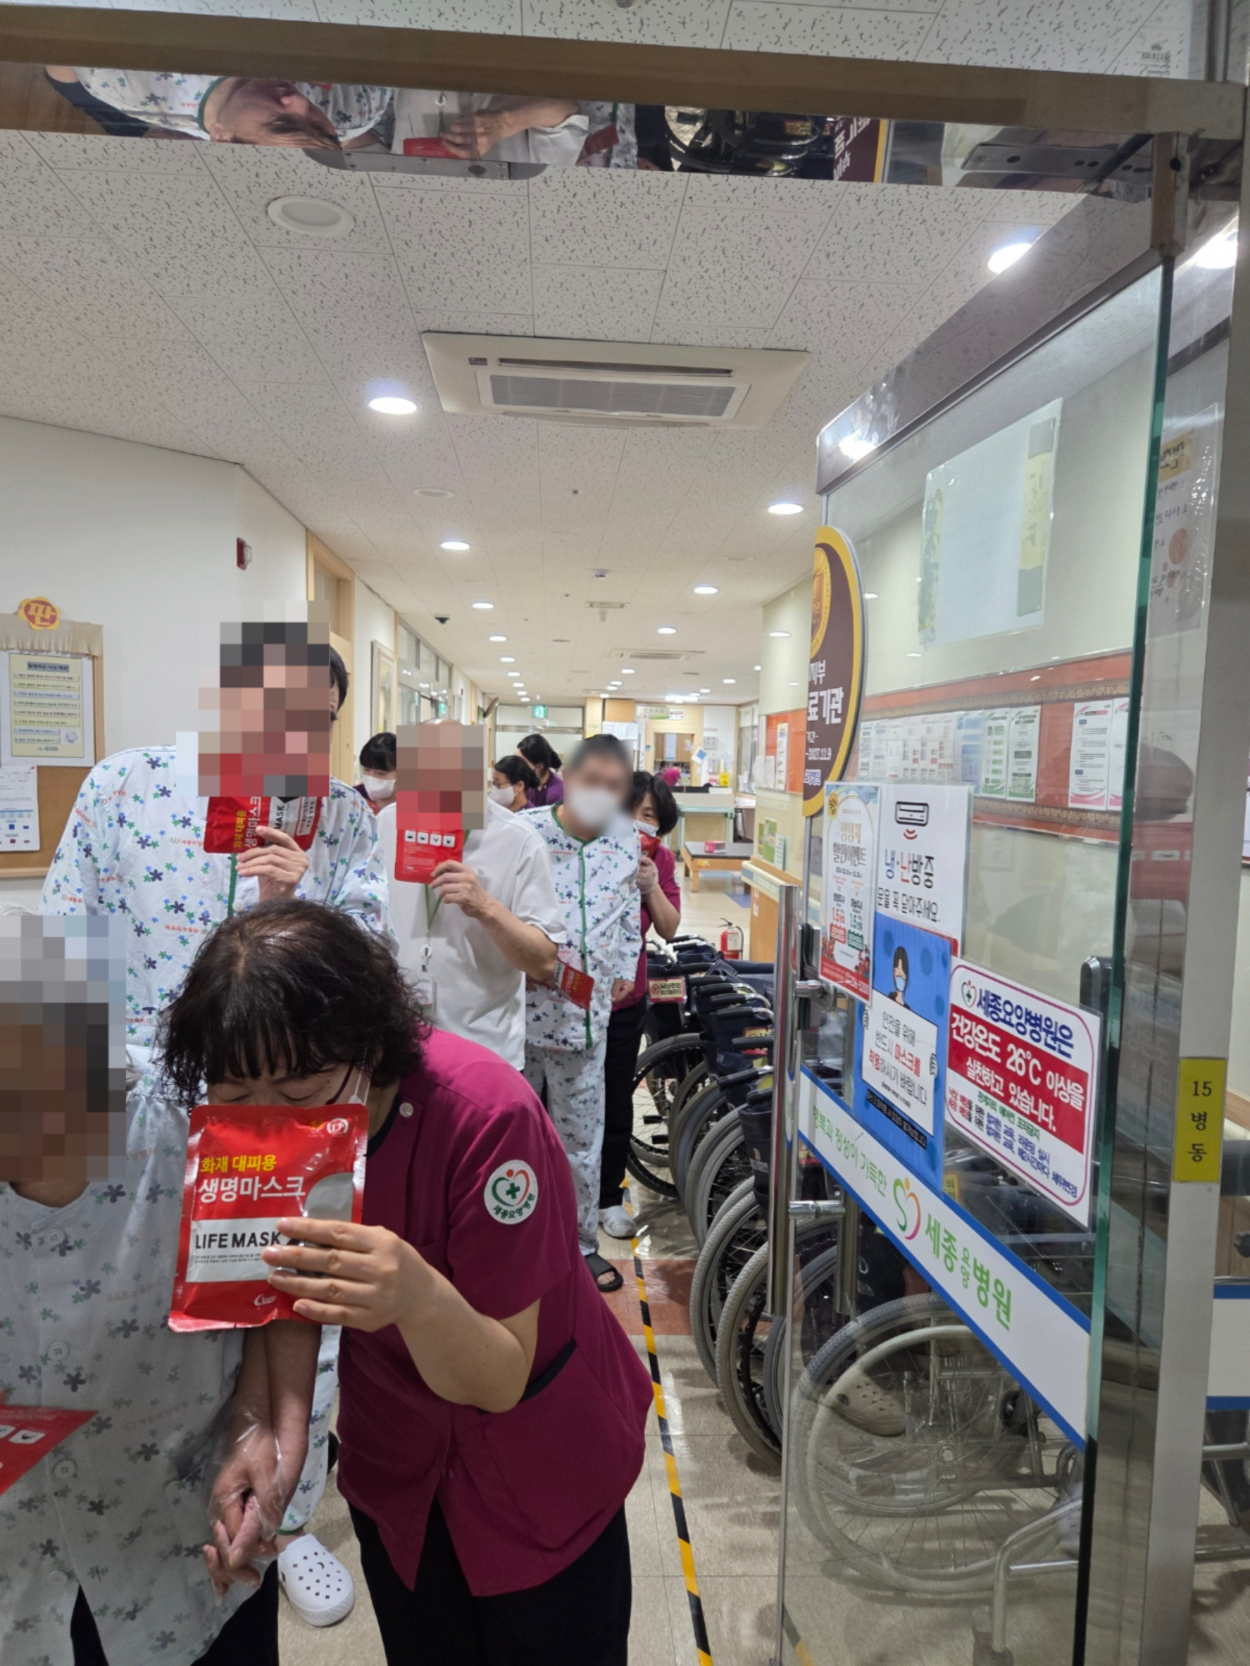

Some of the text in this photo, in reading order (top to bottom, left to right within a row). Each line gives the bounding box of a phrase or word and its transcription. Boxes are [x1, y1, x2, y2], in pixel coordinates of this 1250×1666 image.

[275, 805, 285, 830] MASK
[882, 1011, 916, 1047] 안전을 위해
[977, 988, 1074, 1059] 세종요양병원은
[875, 1030, 921, 1077] 반드시 마스크를
[951, 1012, 1001, 1063] 건강온도
[1046, 1071, 1085, 1111] 이상을
[966, 1057, 1005, 1097] 실천하고
[1008, 1082, 1057, 1132] 있습니다.
[201, 1154, 277, 1174] 화재 대피용
[813, 1105, 887, 1197] 행복과 정성이 가득한
[198, 1176, 306, 1204] 생명마스크
[195, 1231, 282, 1250] LIFE MASK
